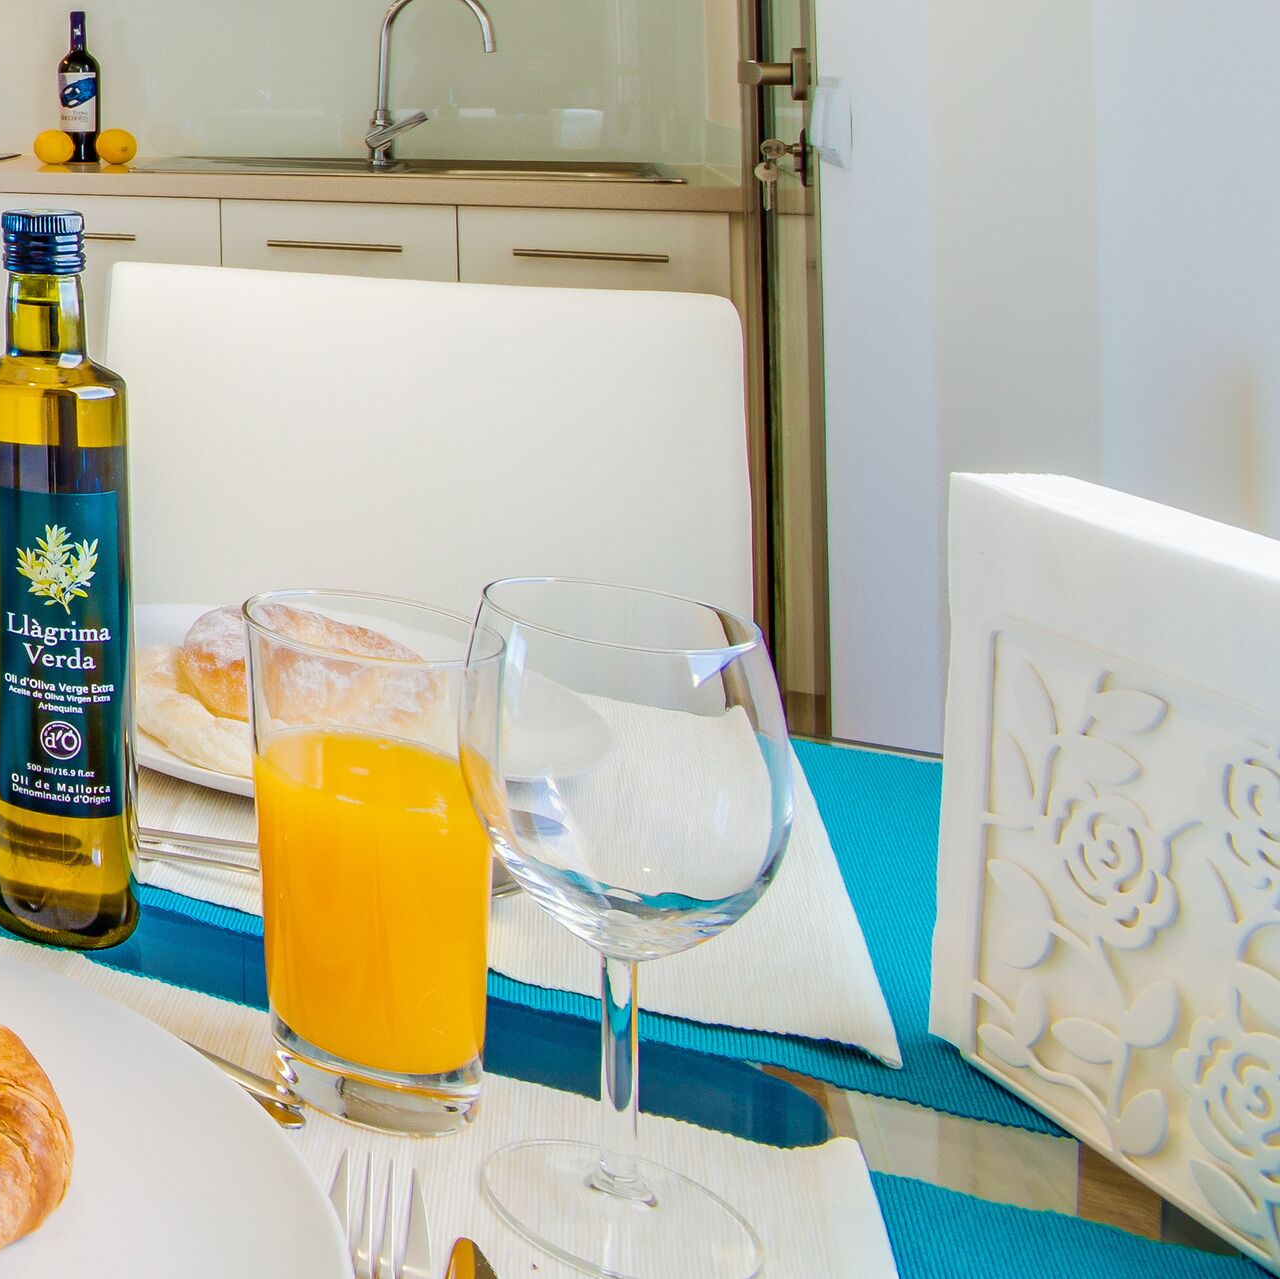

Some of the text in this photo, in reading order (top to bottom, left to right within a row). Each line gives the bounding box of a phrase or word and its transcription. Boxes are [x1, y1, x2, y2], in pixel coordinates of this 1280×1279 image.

[6, 611, 111, 646] Llàgrima
[22, 642, 96, 669] Verda
[4, 672, 114, 695] Oli d'Oliva Verge Extra
[8, 684, 111, 704] Aceite de Oliva Virgen Extra
[37, 701, 83, 714] Arbequina
[26, 762, 42, 772] 500
[43, 766, 76, 777] ml/16.9
[11, 772, 111, 794] Oli de Mallorca
[12, 782, 111, 805] Denominació d'Origen
